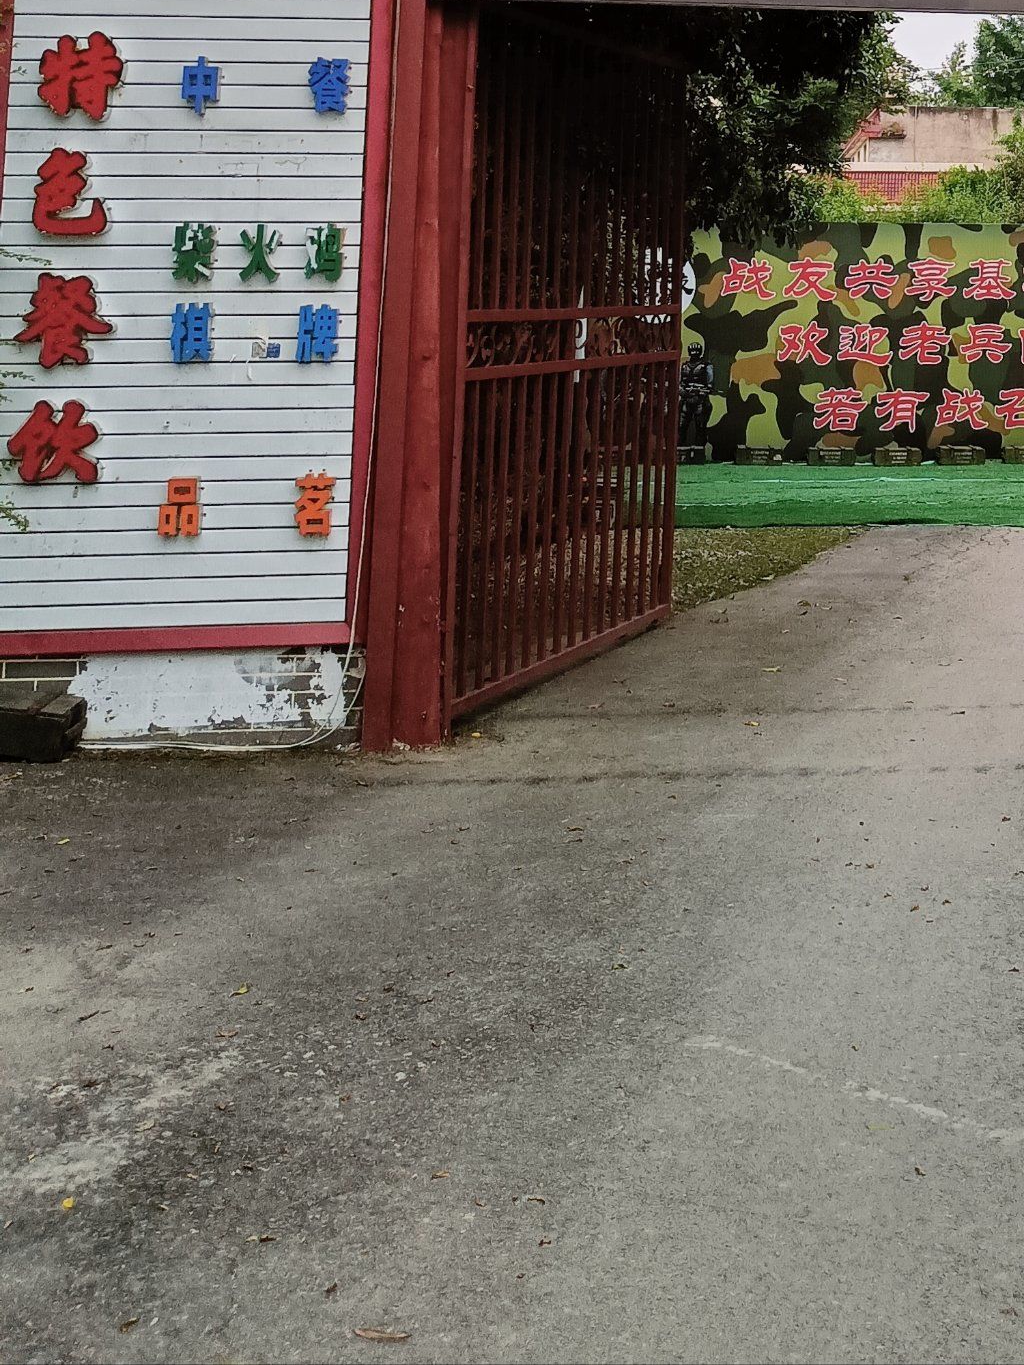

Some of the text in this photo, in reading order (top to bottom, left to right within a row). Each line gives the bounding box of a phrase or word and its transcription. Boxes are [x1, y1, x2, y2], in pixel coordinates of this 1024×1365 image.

[181, 55, 351, 115] 中餐
[9, 32, 122, 484] 特色餐饮
[170, 302, 341, 363] 棋牌
[157, 474, 336, 538] 品茗
